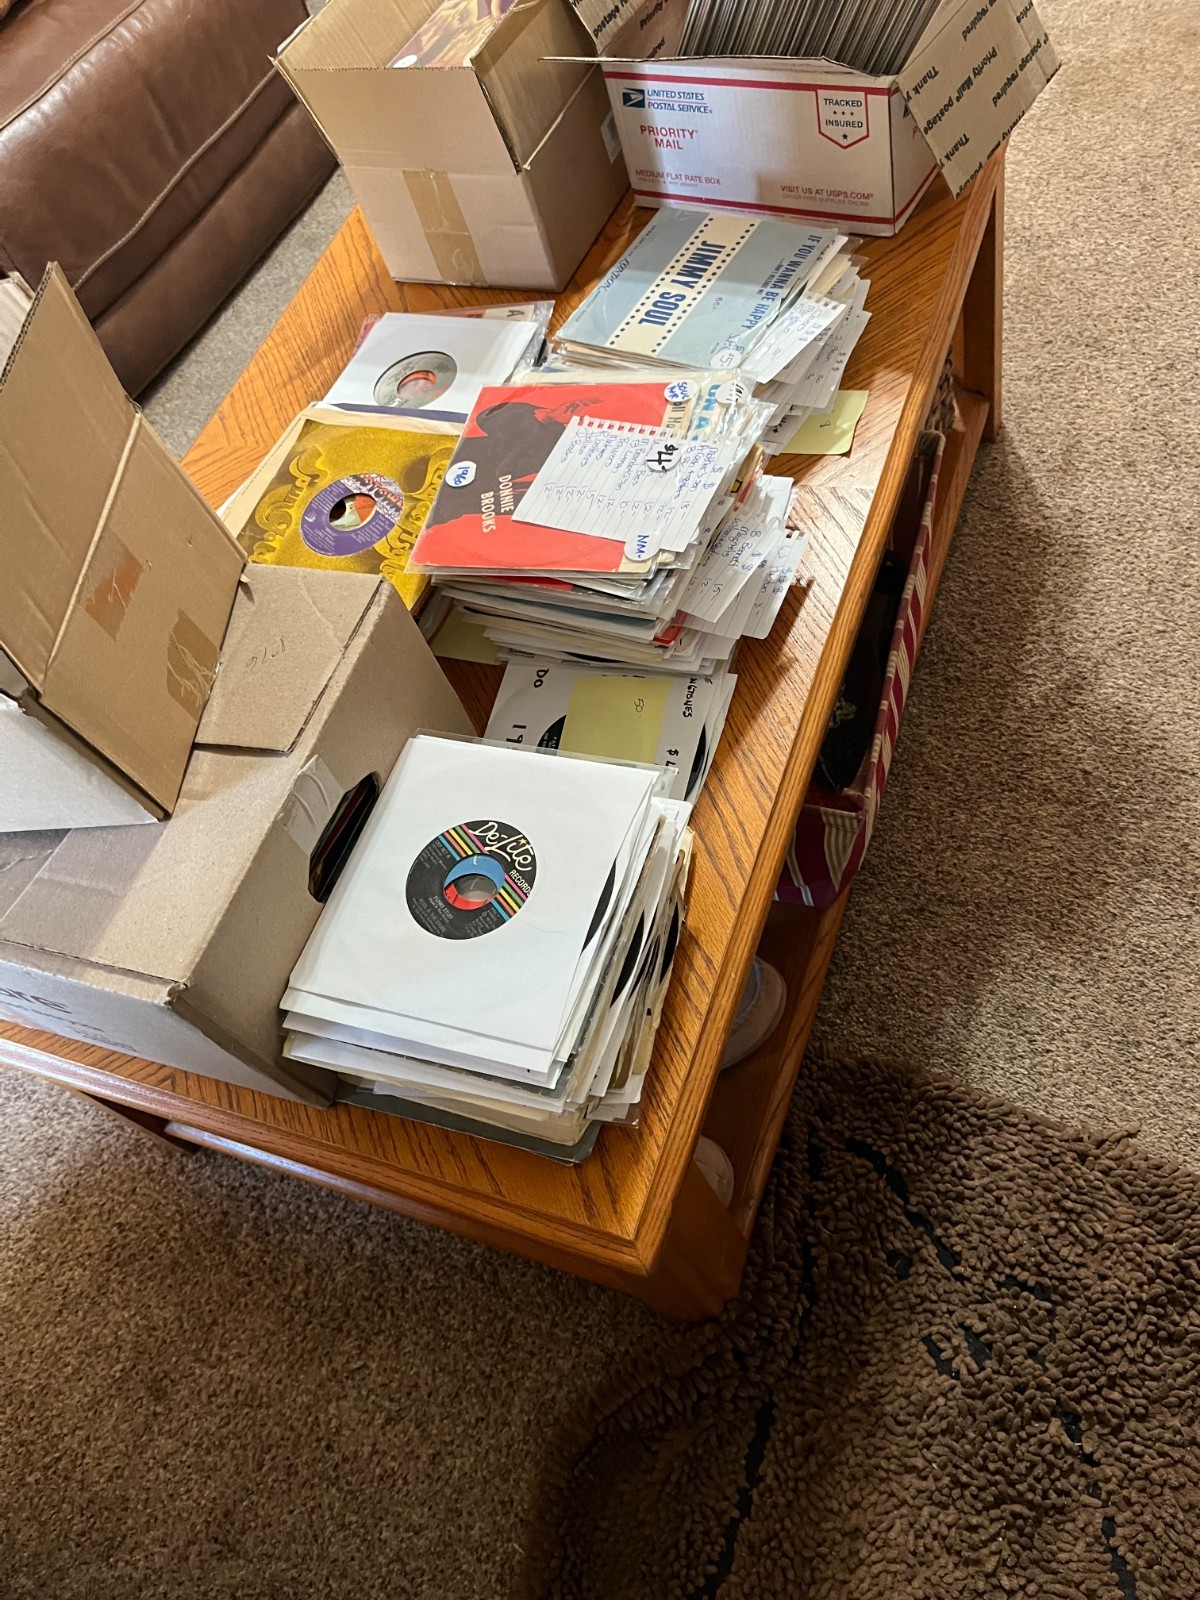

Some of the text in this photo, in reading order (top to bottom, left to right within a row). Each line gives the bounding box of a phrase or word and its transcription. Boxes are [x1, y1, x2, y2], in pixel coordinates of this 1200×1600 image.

[592, 4, 620, 39] postage
[973, 46, 998, 78] Priority
[992, 38, 1042, 108] postage required
[647, 90, 704, 100] UNITED STATES
[914, 66, 939, 96] Thank
[648, 102, 709, 114] POSTAL SERVICE
[824, 98, 862, 107] TRACKED
[923, 96, 954, 135] postage
[640, 125, 695, 139] PRIORITY
[826, 119, 863, 128] INSURED
[654, 138, 684, 150] MAIL
[944, 132, 970, 162] Thank
[636, 169, 665, 179] MEDIUM
[684, 175, 703, 183] RATE
[704, 176, 721, 185] BOX
[781, 185, 800, 194] VISIT
[801, 187, 813, 195] US
[794, 244, 816, 260] YOU
[808, 235, 822, 244] IF
[670, 240, 726, 289] JIMMY
[770, 260, 803, 290] WANNA
[638, 292, 686, 326] SOUL
[761, 291, 779, 302] BE
[742, 303, 770, 330] HAPPY
[499, 474, 514, 513] DONNIE
[481, 490, 496, 533] BROOKS
[468, 822, 534, 871] De-Lite
